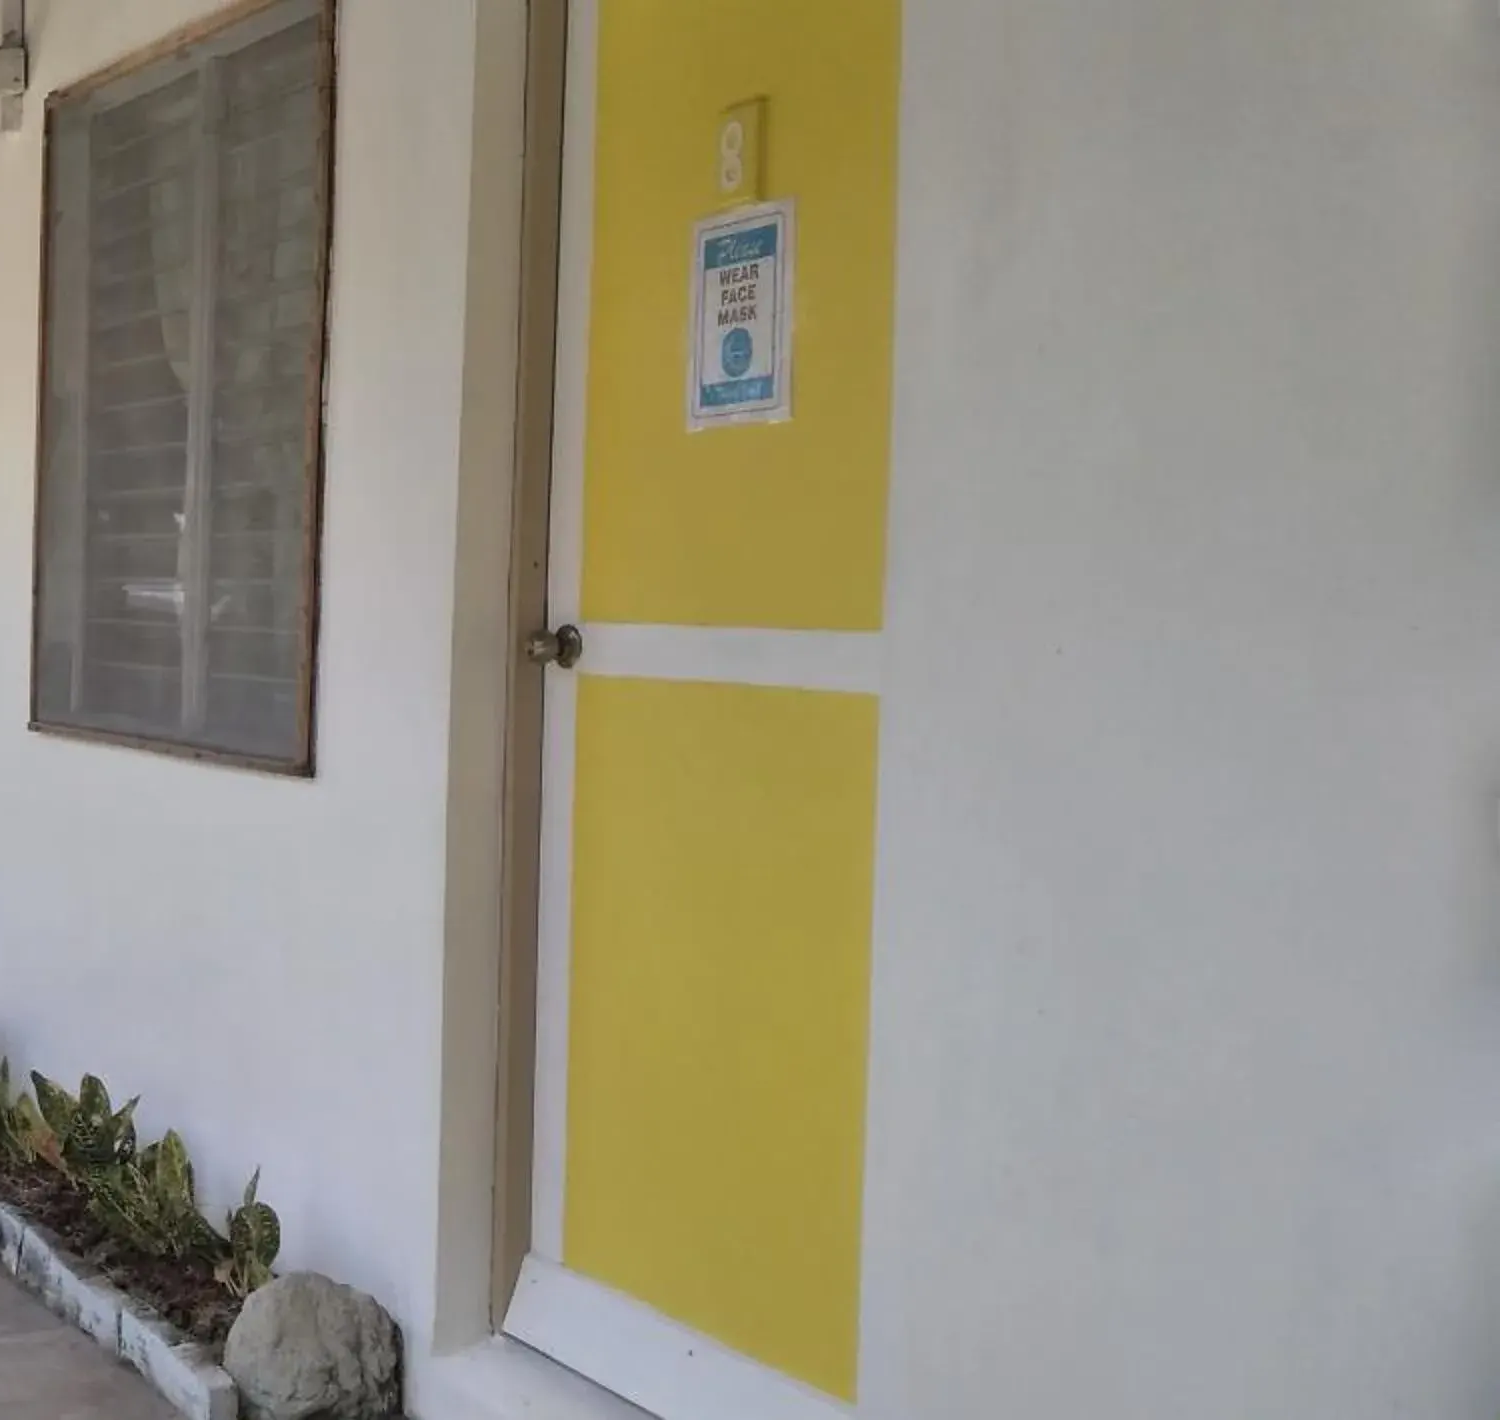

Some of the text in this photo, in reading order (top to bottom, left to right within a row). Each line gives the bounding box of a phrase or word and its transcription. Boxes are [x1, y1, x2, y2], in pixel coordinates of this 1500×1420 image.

[720, 120, 743, 190] 8
[719, 264, 759, 286] WEAR
[721, 284, 757, 306] FACE
[717, 304, 757, 327] MASK
